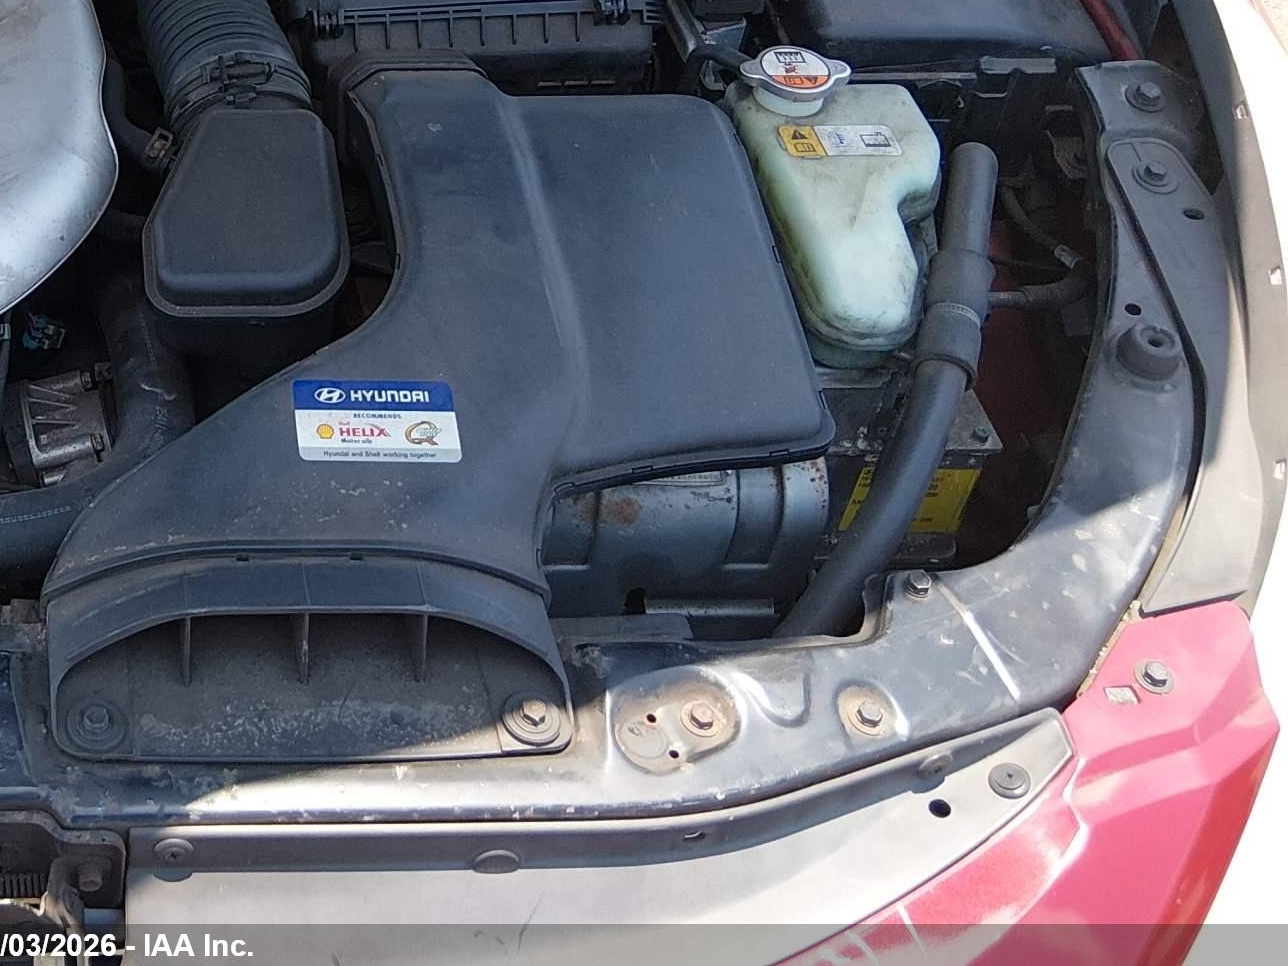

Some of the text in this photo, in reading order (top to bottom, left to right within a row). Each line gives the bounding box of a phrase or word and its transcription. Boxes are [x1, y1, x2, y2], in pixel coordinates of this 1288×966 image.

[350, 389, 430, 403] HYUNDAI
[339, 426, 390, 437] HELIX
[323, 450, 350, 458] Hyundai
[383, 450, 409, 459] working
[410, 451, 437, 459] together
